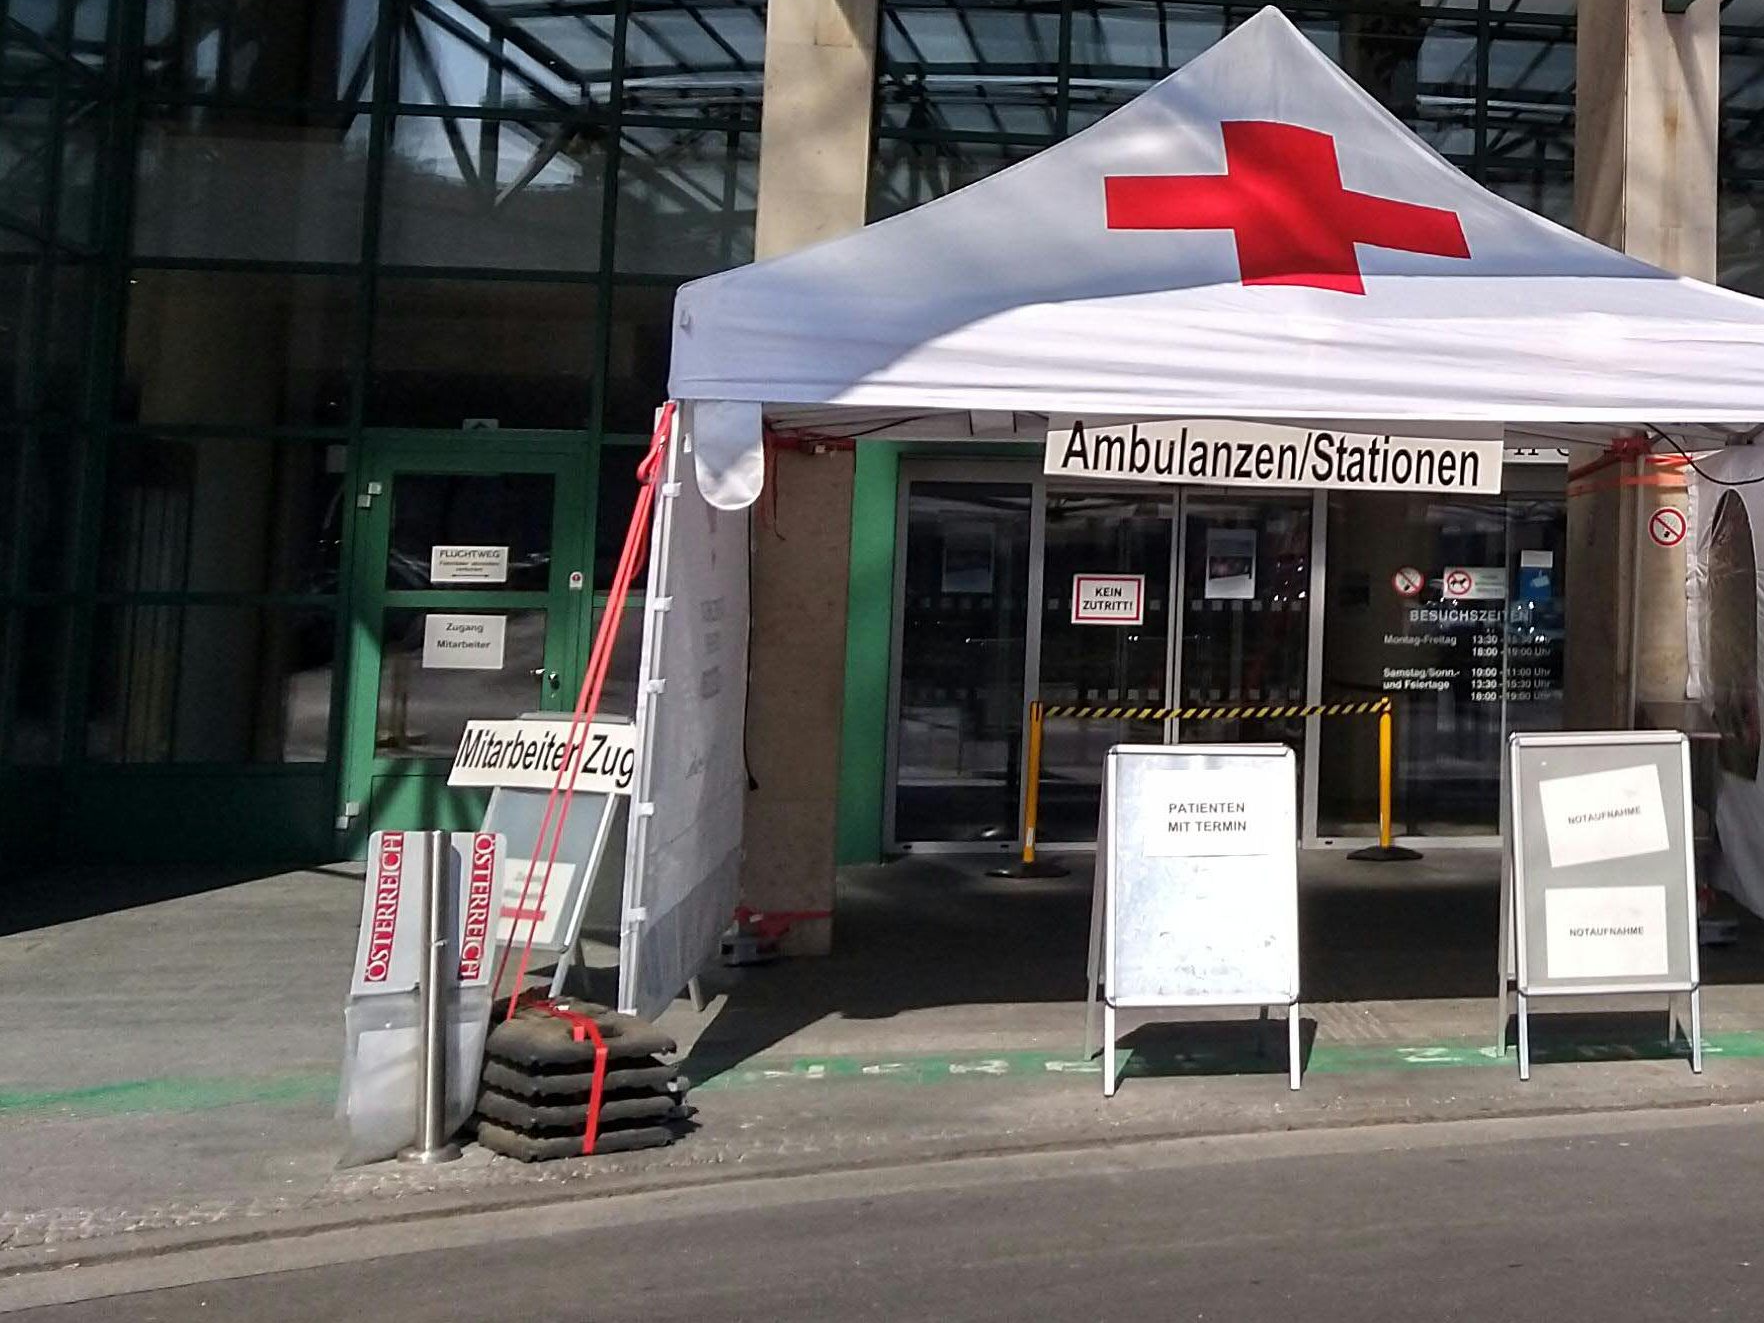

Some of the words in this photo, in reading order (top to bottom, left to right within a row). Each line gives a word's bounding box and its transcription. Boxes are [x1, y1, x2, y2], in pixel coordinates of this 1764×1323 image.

[1061, 420, 1480, 487] Ambulanzen/Stationen
[440, 549, 500, 558] FLUCHTWEG
[1095, 587, 1122, 597] KEIN
[1083, 600, 1133, 611] ZUTRITT!
[1409, 609, 1530, 623] BESUCHSZEITEN
[446, 622, 484, 634] Zugang
[437, 639, 490, 649] Mitarbeiter
[1384, 634, 1457, 646] Montag-Freitag
[1383, 679, 1402, 690] und
[1404, 679, 1450, 691] Feiertage
[455, 729, 579, 771] Mitarbeiter
[1168, 802, 1245, 814] PATIENTEN
[1568, 805, 1641, 824] NOTAUFNAHME
[1168, 821, 1191, 832] MIT
[1195, 821, 1247, 832] TERMIN
[365, 834, 402, 981] ÖSTERREICH
[459, 833, 495, 980] ÖSTERREICH
[1569, 926, 1644, 937] NOTAUFNAHME
